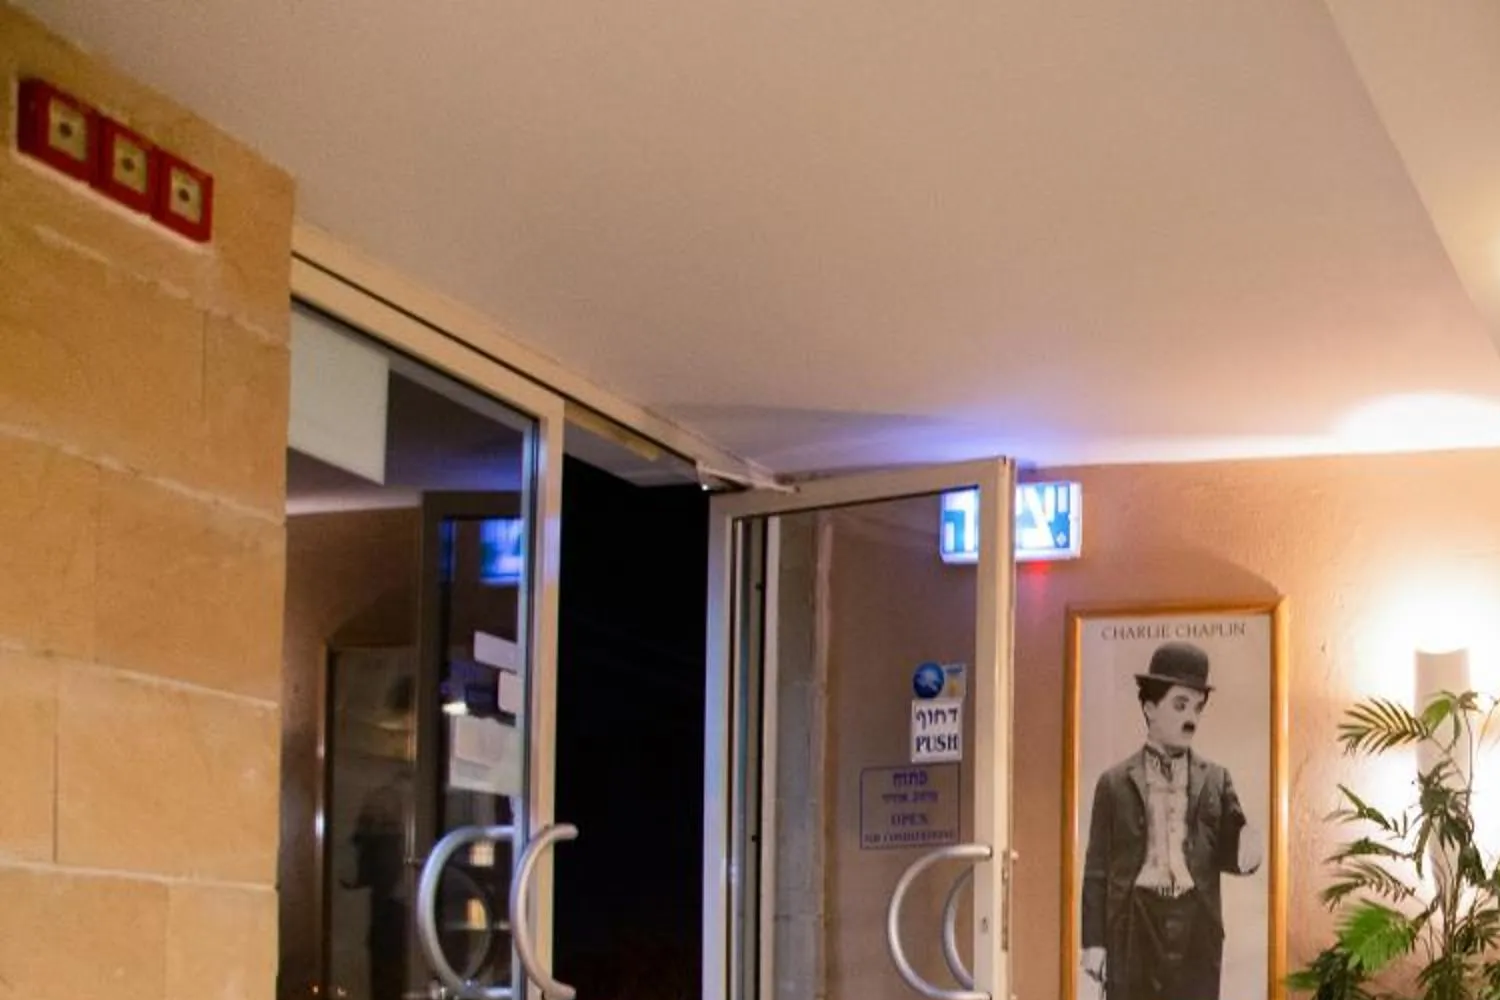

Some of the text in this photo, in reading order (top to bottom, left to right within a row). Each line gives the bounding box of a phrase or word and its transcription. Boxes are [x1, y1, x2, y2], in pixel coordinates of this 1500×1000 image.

[1101, 622, 1246, 641] CHARLIE CHAPLIN
[915, 707, 959, 731] דחוף
[915, 734, 959, 753] PUSH
